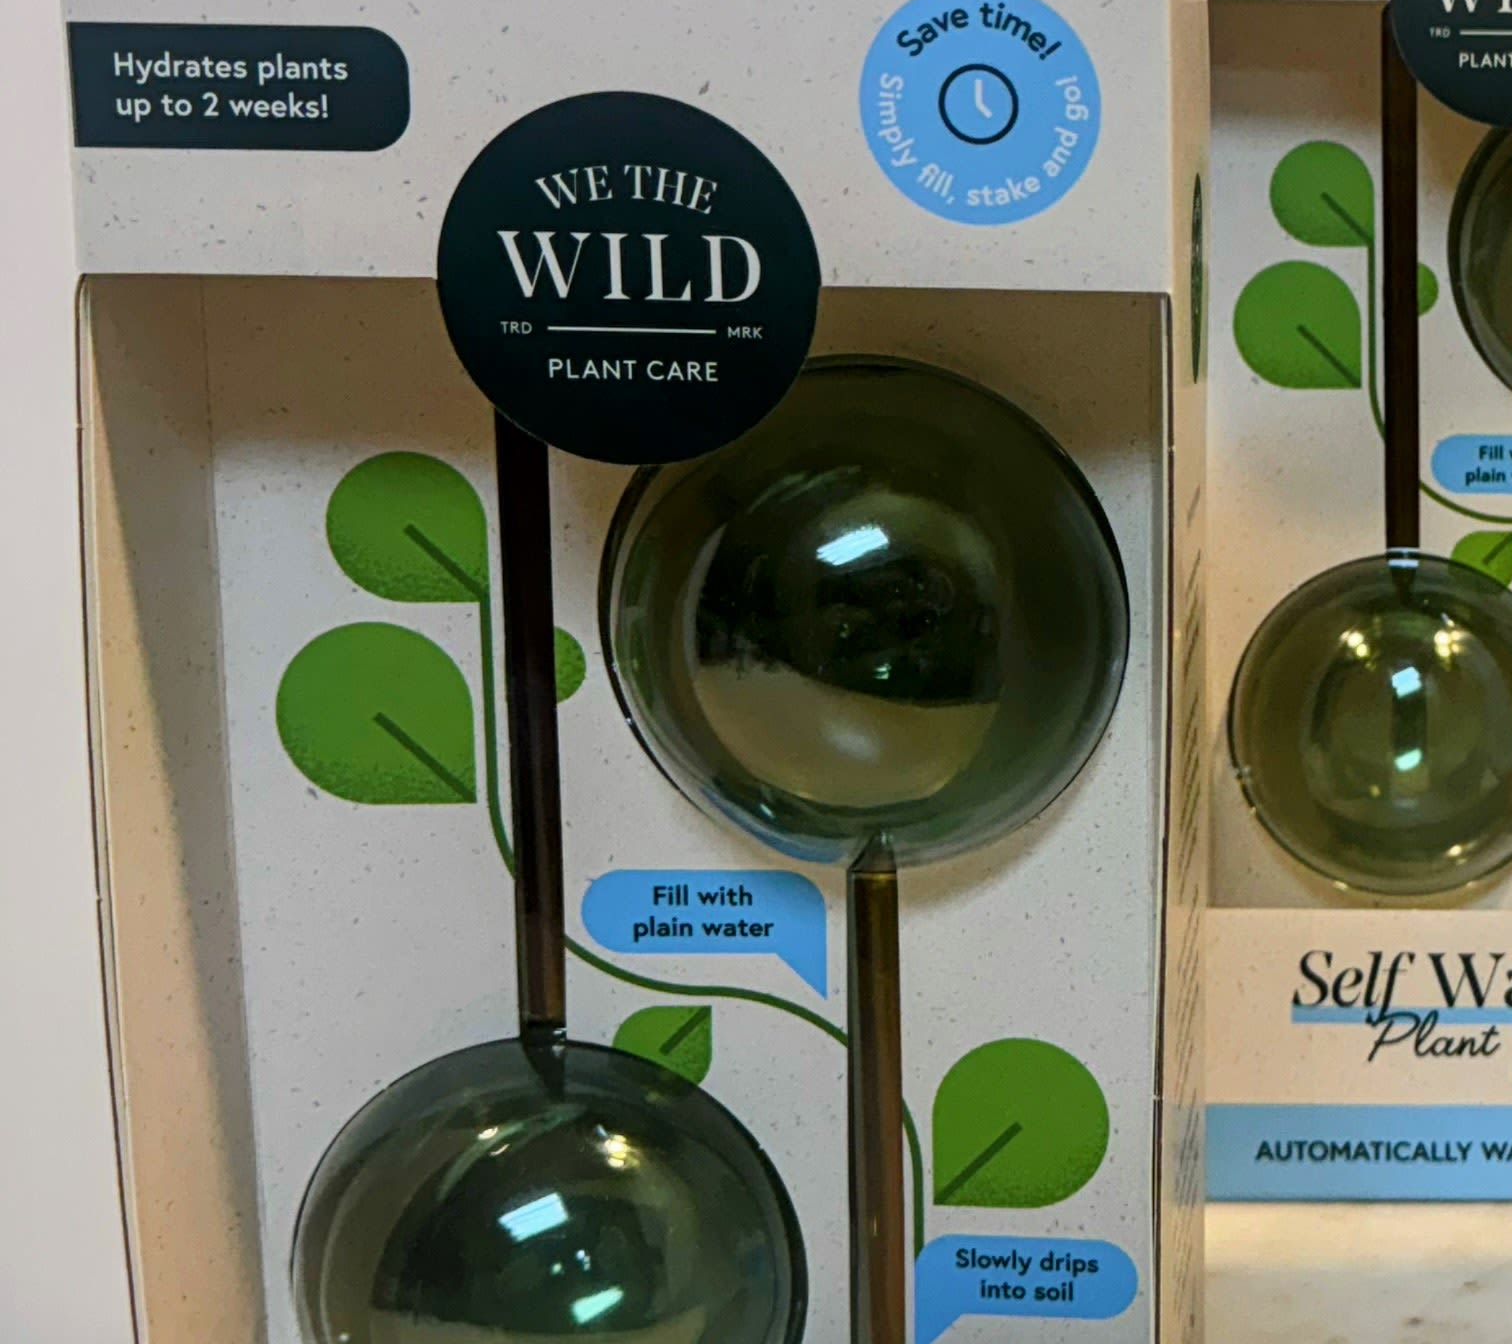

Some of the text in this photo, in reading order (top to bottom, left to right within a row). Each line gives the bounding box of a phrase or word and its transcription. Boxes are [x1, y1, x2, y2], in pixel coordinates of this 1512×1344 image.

[897, 2, 1061, 60] Save time!
[1430, 28, 1450, 38] TRD
[113, 51, 348, 87] Hydrates plants
[115, 91, 329, 123] up to 2 weeks!
[878, 73, 1088, 206] Simply fill, stake and go!
[534, 165, 717, 214] WE THE
[496, 231, 761, 302] WILD
[501, 321, 763, 339] TRD MRK
[549, 358, 718, 381] PLANT CARE
[1479, 445, 1504, 461] Fill
[1465, 467, 1505, 486] plain
[653, 886, 752, 907] Fill with
[633, 917, 774, 943] plain water
[1292, 950, 1415, 1024] Self
[1367, 1012, 1500, 1063] Plant
[1256, 1141, 1472, 1164] AUTOMATICALLY
[956, 1248, 1099, 1279] Slowly drips
[980, 1280, 1073, 1303] into soil
